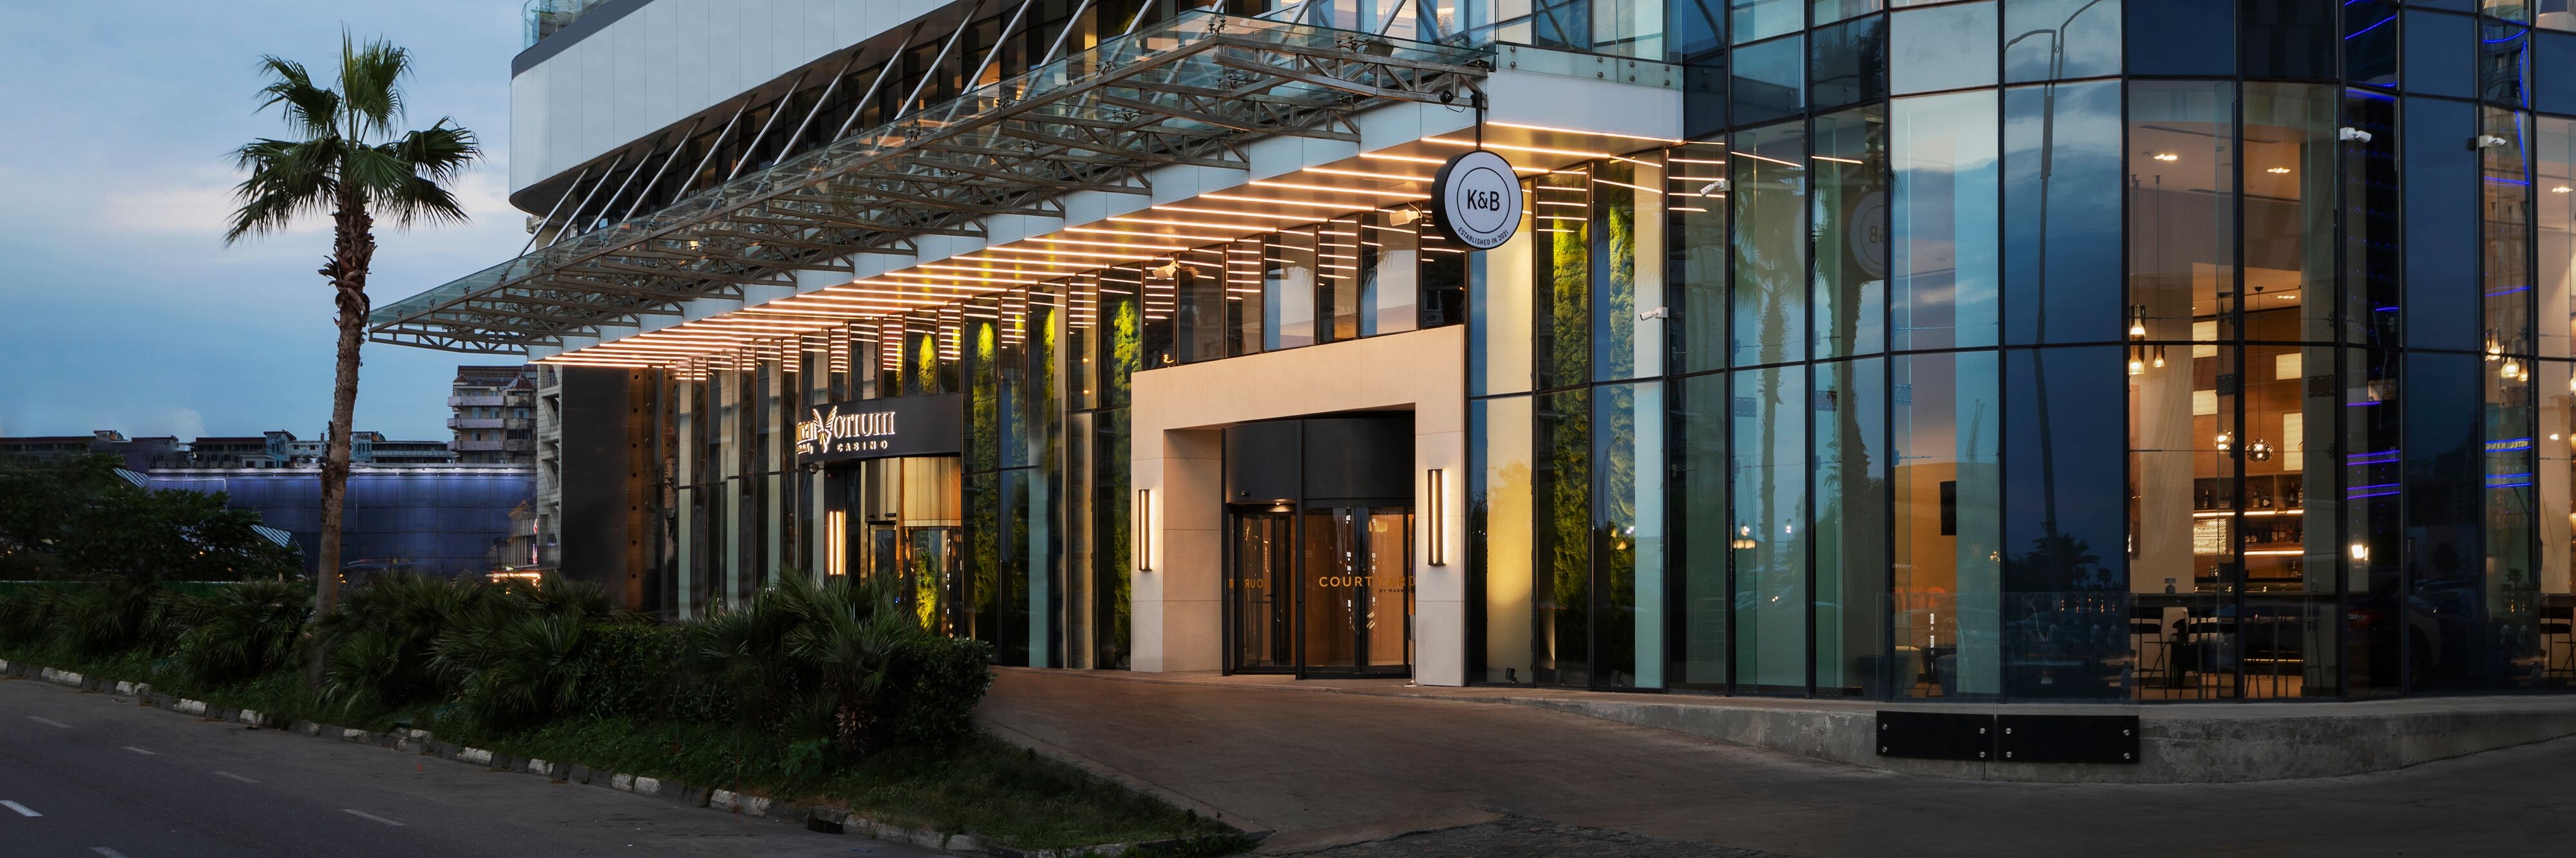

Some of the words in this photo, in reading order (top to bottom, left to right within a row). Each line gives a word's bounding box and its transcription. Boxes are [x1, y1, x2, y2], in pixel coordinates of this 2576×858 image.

[1467, 189, 1500, 211] K&B
[1458, 227, 1490, 245] ESTABLISHED
[1497, 229, 1509, 241] 2021
[837, 440, 888, 452] CASINO
[1319, 576, 1416, 587] COURTYARD
